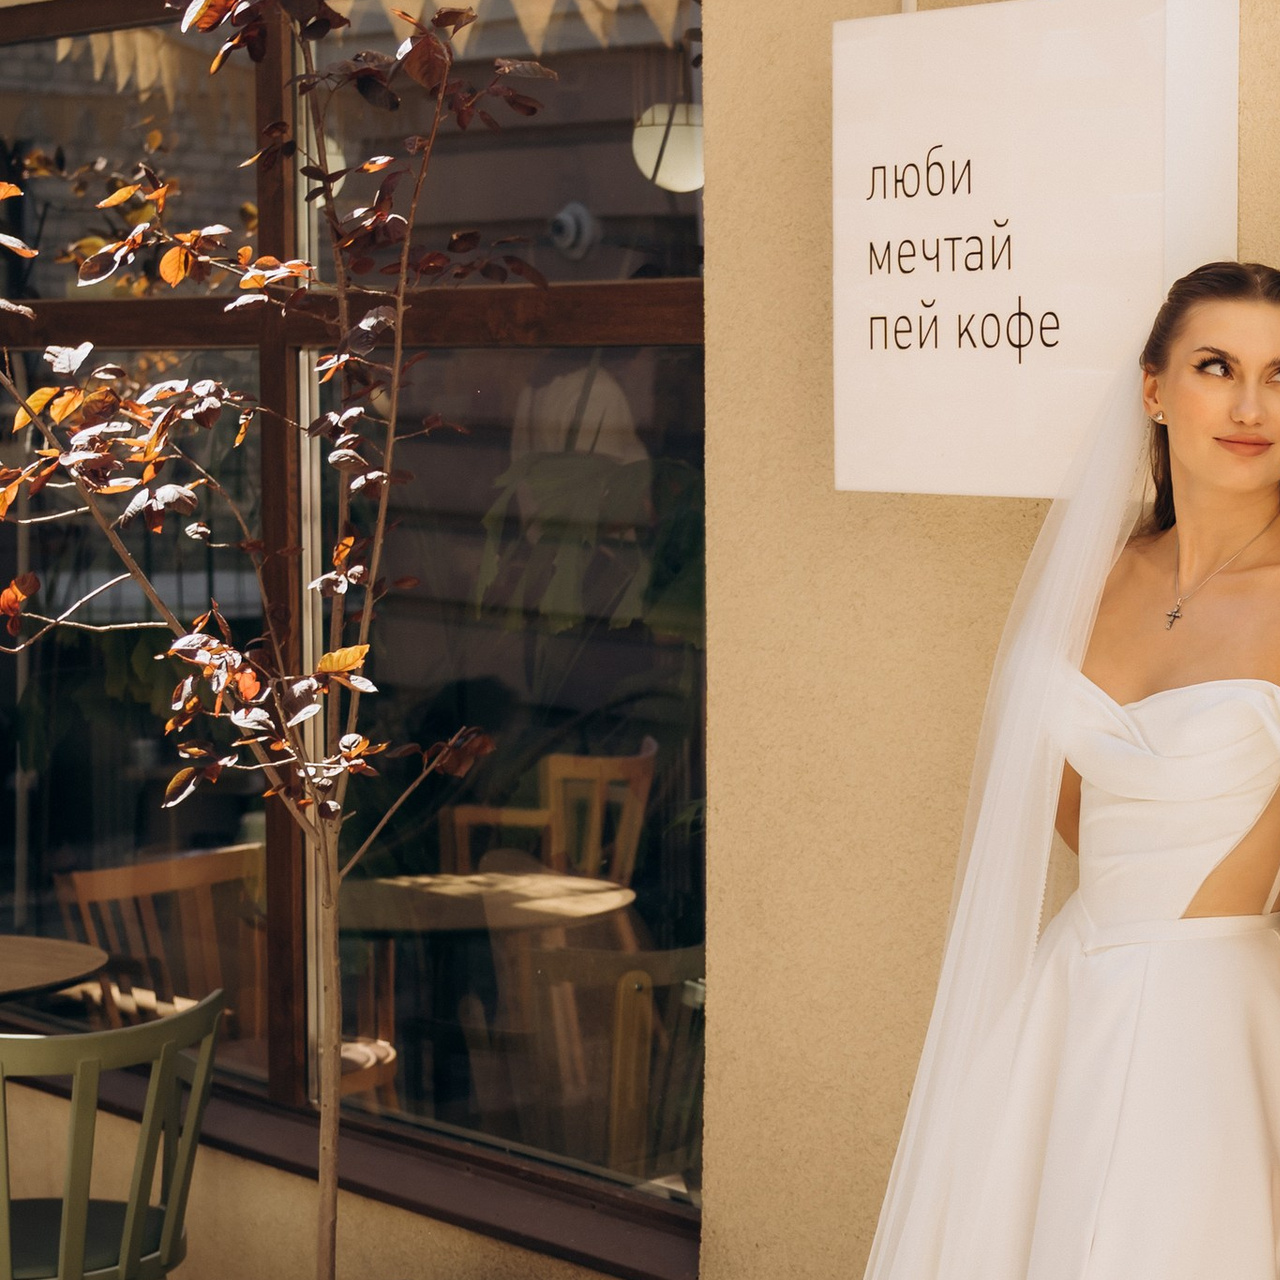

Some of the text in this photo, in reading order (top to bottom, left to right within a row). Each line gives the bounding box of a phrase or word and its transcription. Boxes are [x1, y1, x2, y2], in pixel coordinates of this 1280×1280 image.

[865, 144, 972, 200] люби
[868, 218, 1012, 275] мечтай
[868, 296, 1060, 364] пей кофе
